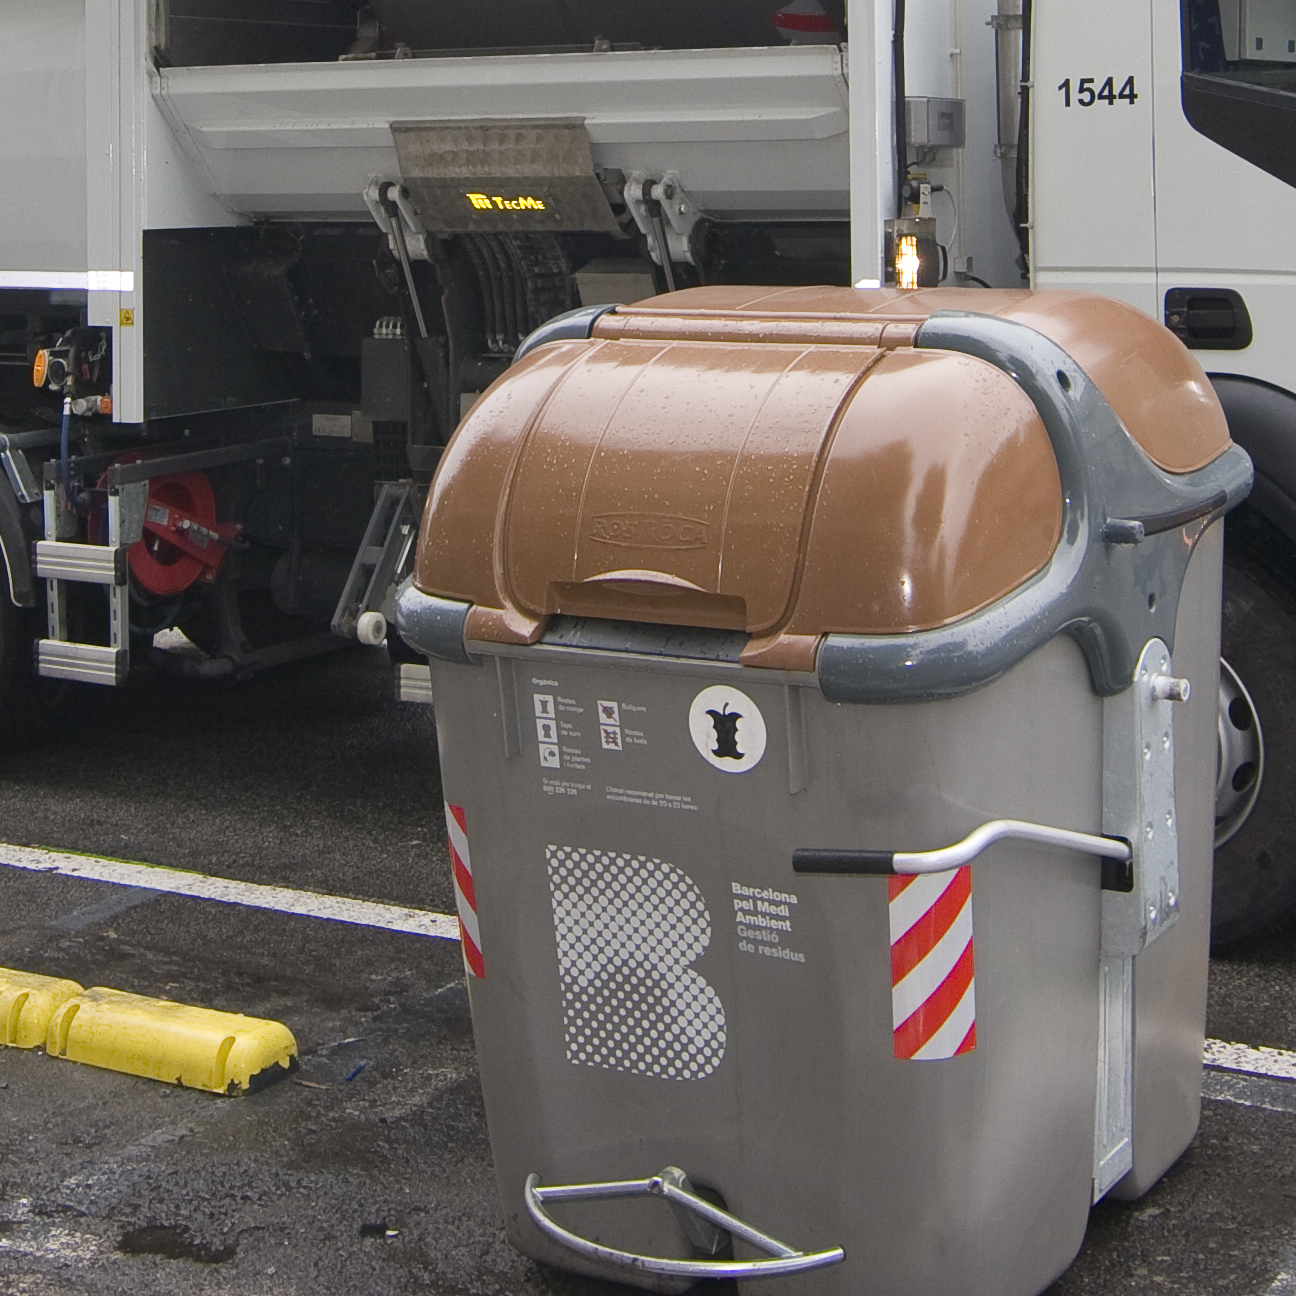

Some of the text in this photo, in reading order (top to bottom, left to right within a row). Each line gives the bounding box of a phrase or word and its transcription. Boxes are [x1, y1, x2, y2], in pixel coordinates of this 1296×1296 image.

[1057, 75, 1139, 108] 1544
[731, 882, 798, 904] Barcelona
[733, 898, 790, 917] pel Medi
[735, 911, 792, 932] Ambient
[737, 925, 779, 943] Gestió
[738, 940, 806, 963] de residus
